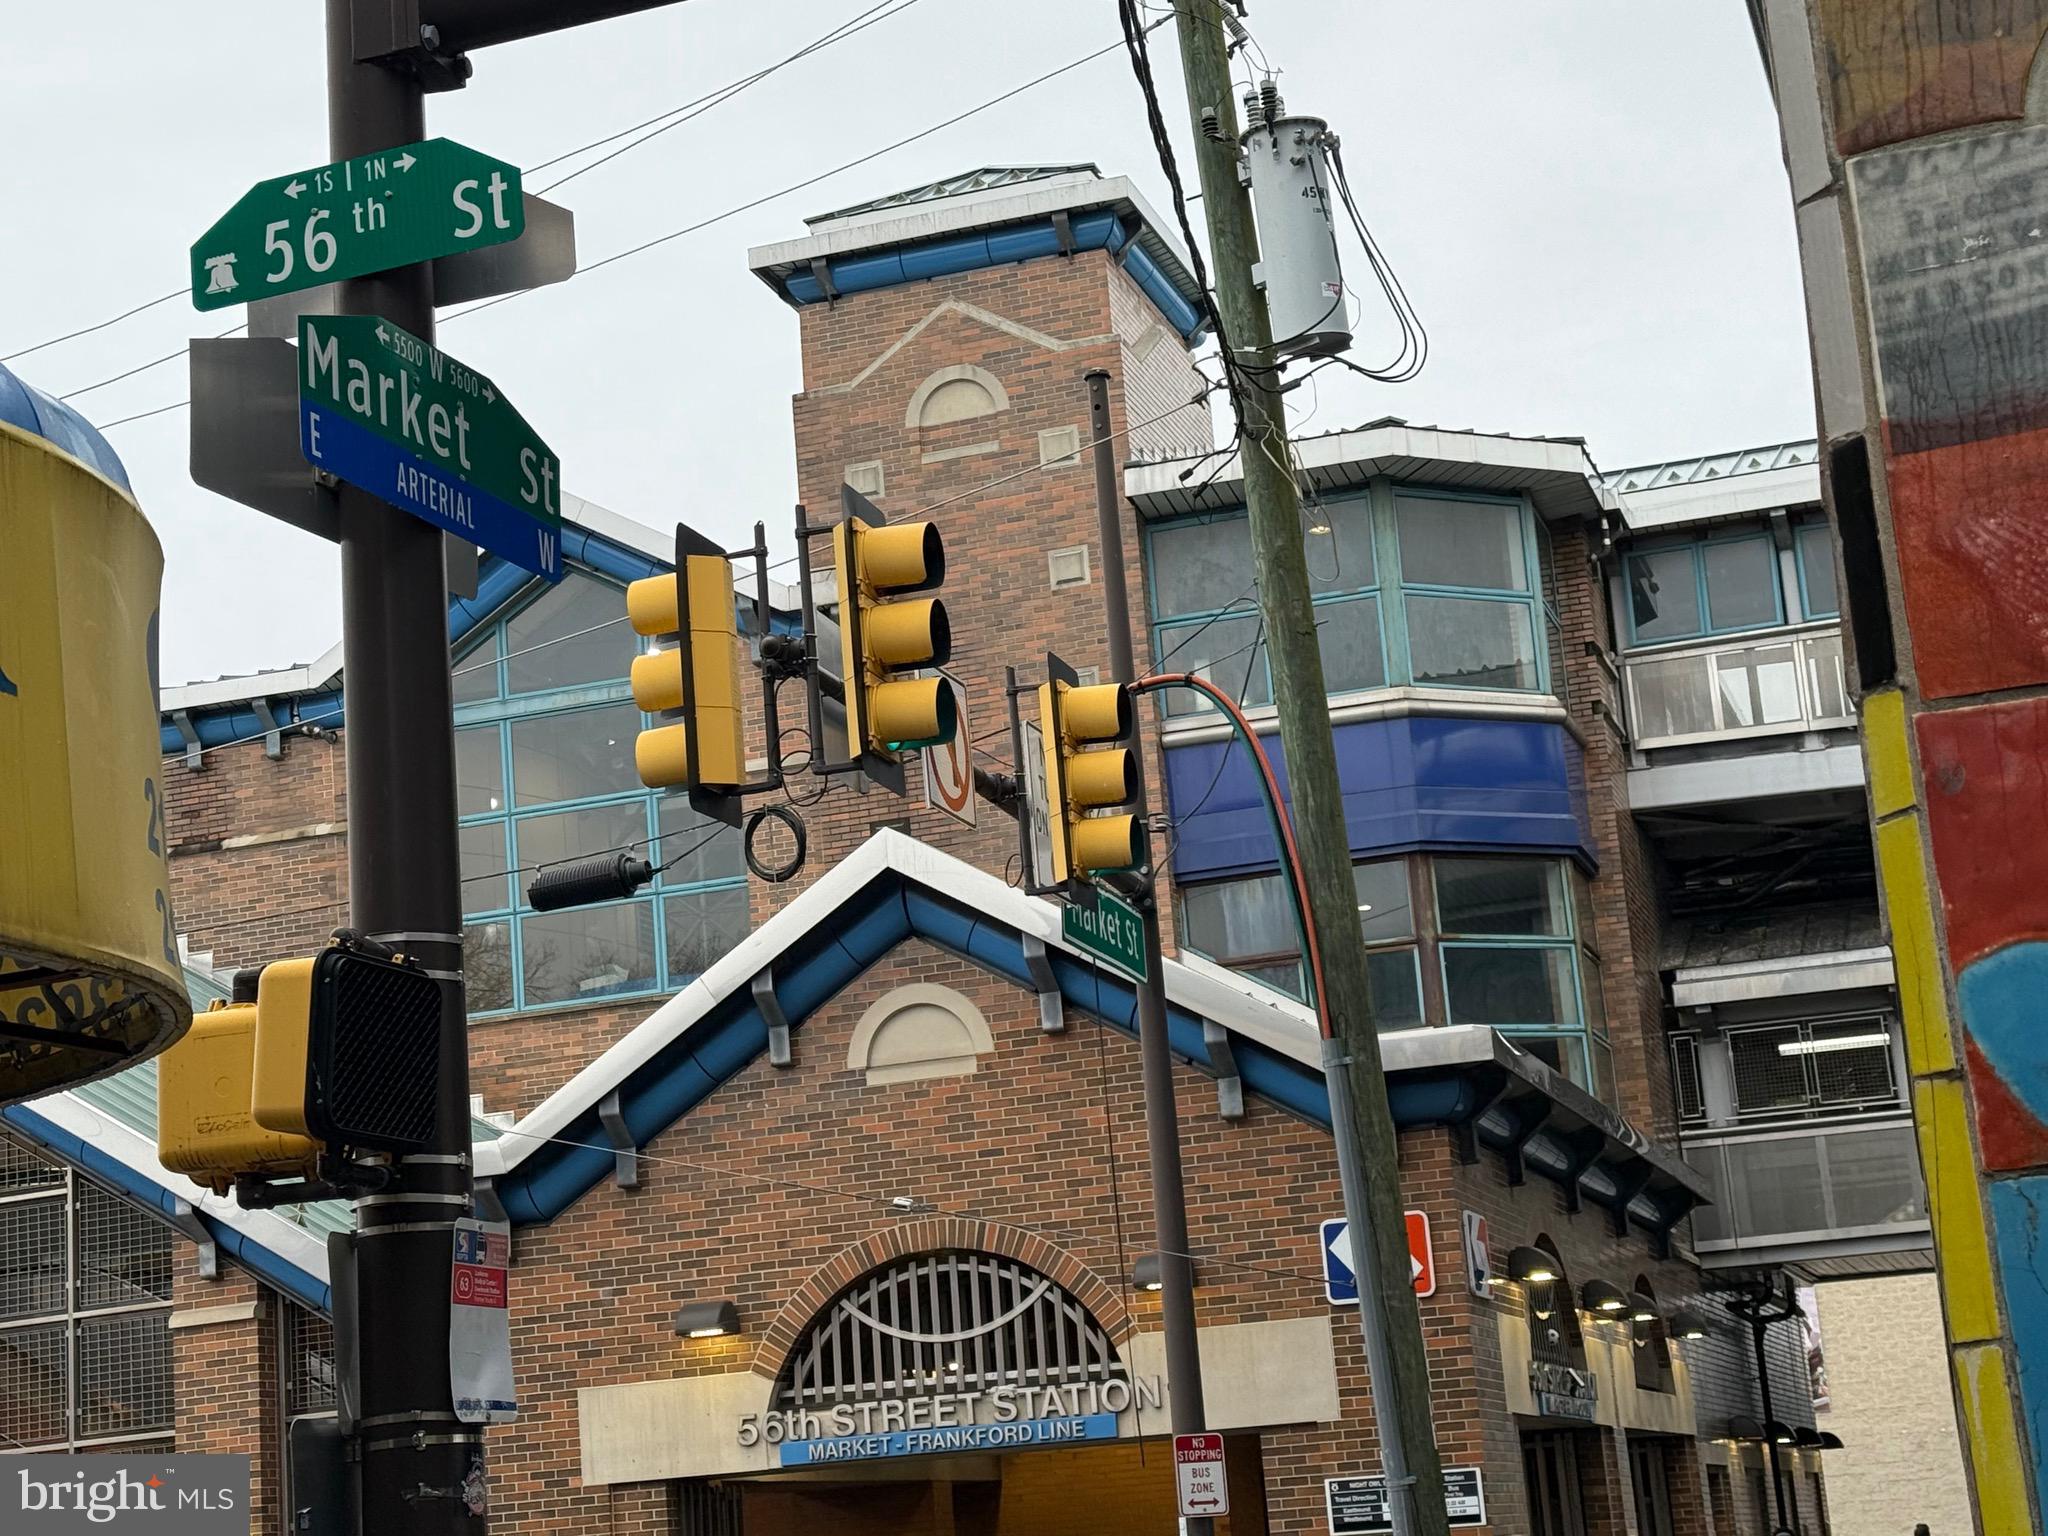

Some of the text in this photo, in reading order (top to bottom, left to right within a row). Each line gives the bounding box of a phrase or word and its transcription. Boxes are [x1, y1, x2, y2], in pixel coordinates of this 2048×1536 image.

[315, 158, 387, 194] 1S 1N
[264, 171, 511, 284] 56 th St
[394, 333, 479, 398] 5500 W 5600
[306, 322, 555, 516] Market St
[310, 411, 322, 459] E
[397, 461, 475, 530] ARTERIAL
[538, 528, 555, 575] W
[1126, 919, 1139, 960] St
[459, 1276, 469, 1292] 63
[737, 1375, 1162, 1447] 56th STREET STATION
[808, 1436, 891, 1462] MARKET
[906, 1424, 1033, 1452] FRANKFORD
[1038, 1420, 1086, 1440] LINE
[1178, 1449, 1222, 1461] STOPPING
[1192, 1438, 1205, 1448] NO
[1190, 1482, 1215, 1494] ZONE
[1191, 1467, 1211, 1478] BUS
